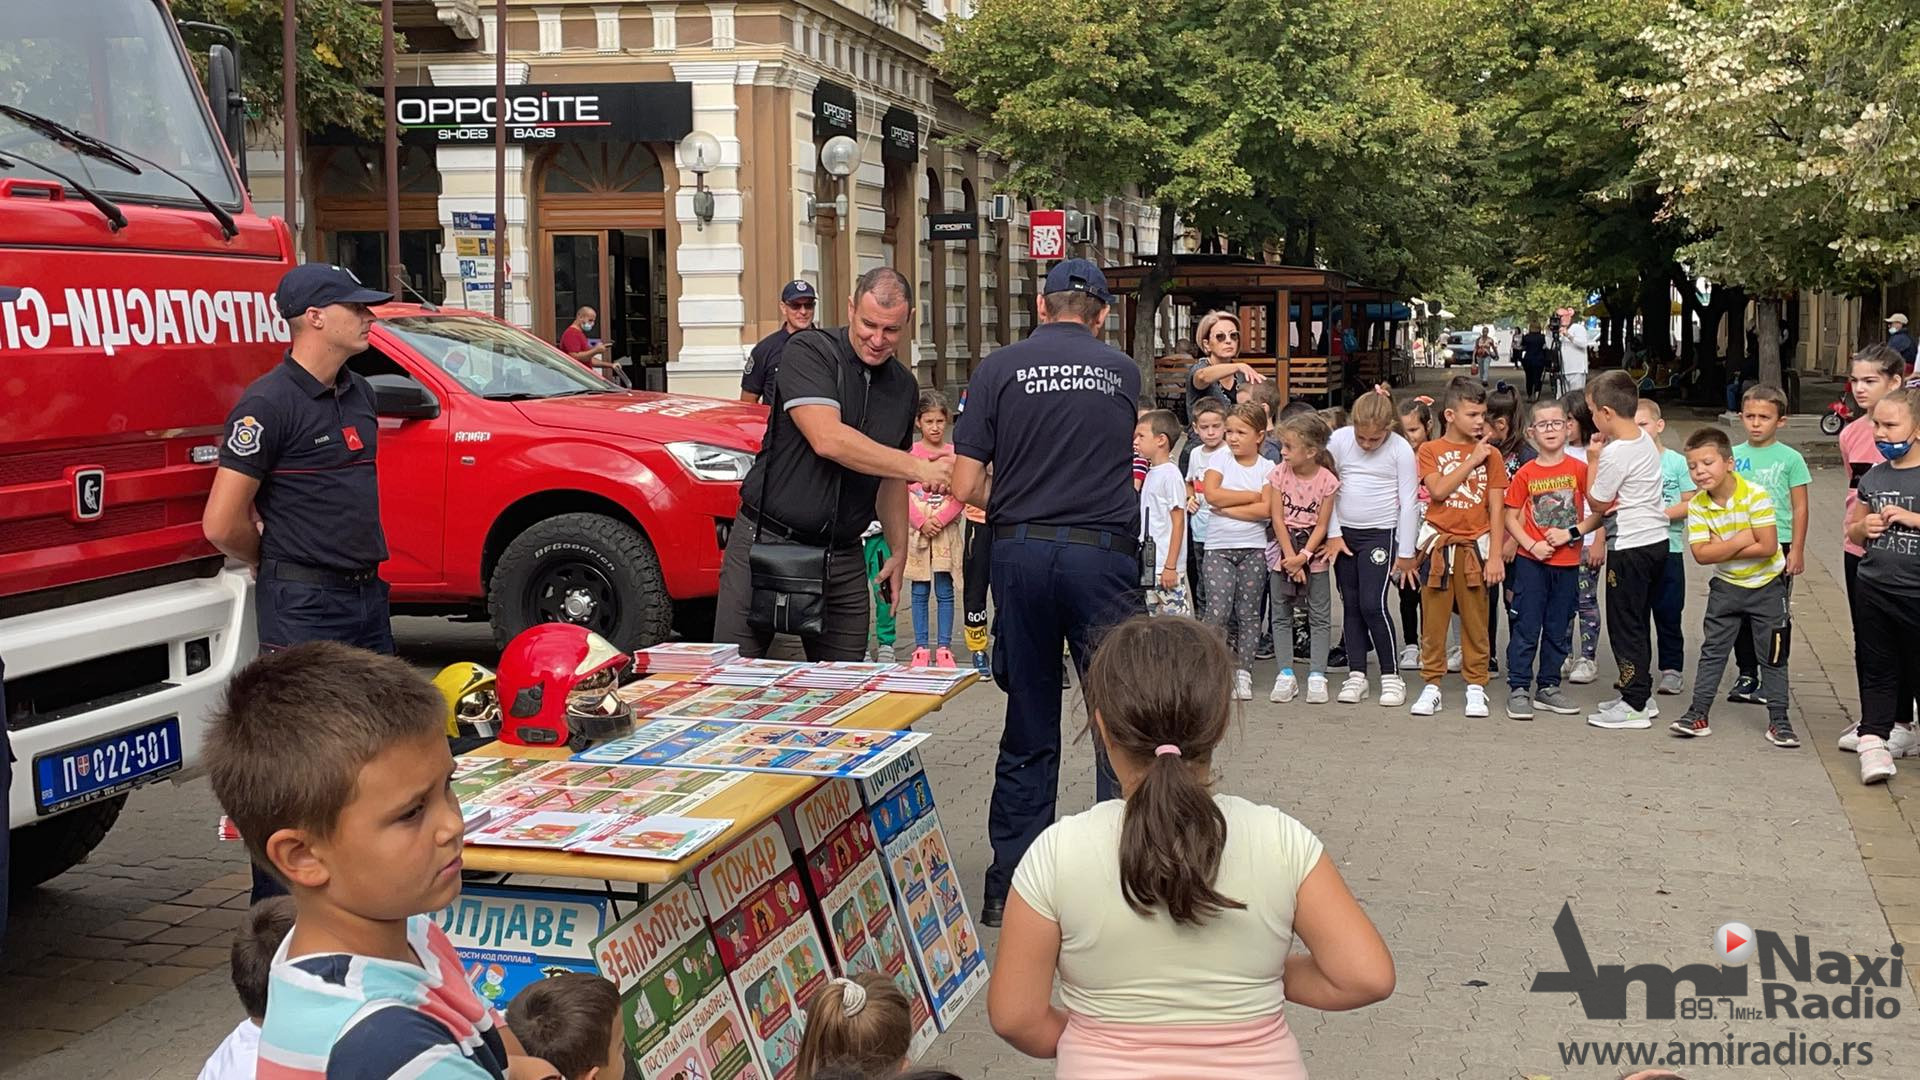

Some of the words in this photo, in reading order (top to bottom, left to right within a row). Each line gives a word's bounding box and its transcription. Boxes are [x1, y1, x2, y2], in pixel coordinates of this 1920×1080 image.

[438, 129, 488, 139] SHOES
[514, 128, 556, 138] BAGS
[1016, 365, 1122, 388] ВАТРОГАСЦИ
[1025, 378, 1115, 396] СПАСИОЦИ
[534, 543, 615, 571] BFGoodrich
[804, 779, 850, 845] ПОЖАР
[711, 836, 777, 911] ПОЖАР
[430, 897, 578, 948] ОПЛАВЕ
[456, 951, 481, 960] НОСТИ
[481, 952, 497, 961] КОД
